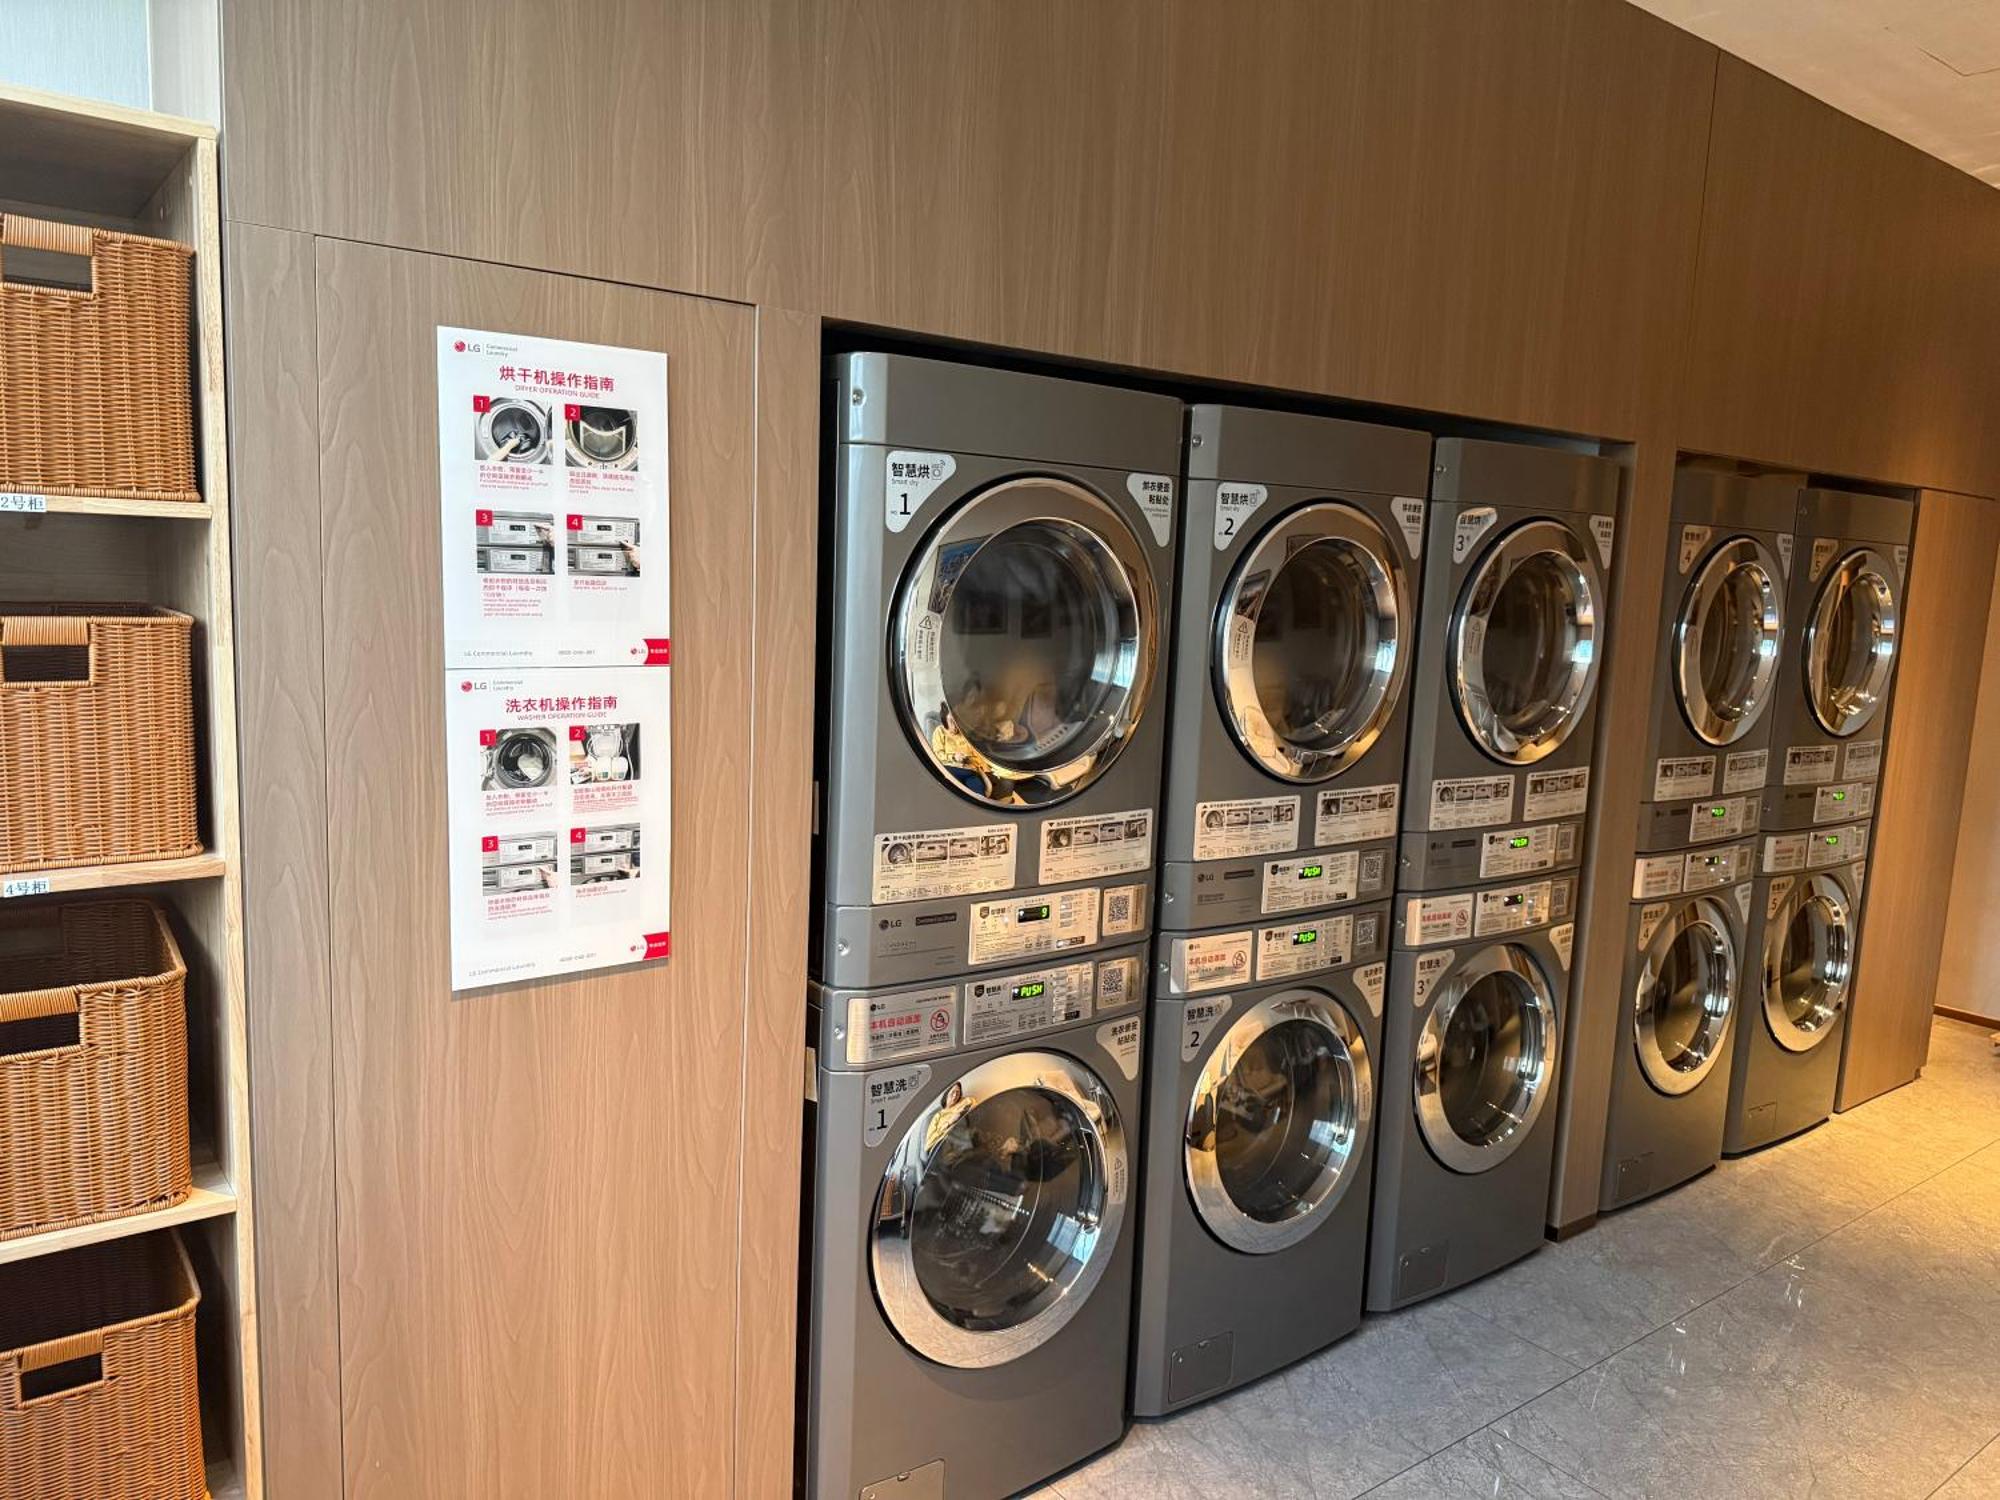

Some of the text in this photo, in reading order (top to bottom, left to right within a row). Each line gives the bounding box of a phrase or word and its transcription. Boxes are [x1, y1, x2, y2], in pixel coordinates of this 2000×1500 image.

[467, 343, 481, 353] LG
[499, 365, 615, 392] 烘干机操作指南
[539, 386, 578, 397] OPERATION
[579, 390, 600, 399] GUIDE
[892, 462, 930, 479] 智慧烘
[0, 495, 44, 511] 2号柜
[900, 492, 911, 515] 1
[1221, 492, 1249, 506] 智慧烘
[1224, 517, 1234, 536] 2
[1455, 534, 1465, 551] 3
[474, 682, 488, 691] LG
[505, 695, 618, 713] 洗衣机操作指南
[547, 711, 586, 720] OPERATION
[587, 711, 608, 719] GUIDE
[6, 880, 48, 896] 4号柜
[890, 919, 902, 929] LG
[1020, 984, 1043, 997] PUSH
[1417, 980, 1425, 995] 3
[1190, 1031, 1200, 1048] 2
[871, 1079, 907, 1098] 智慧洗
[876, 1109, 888, 1130] 1
